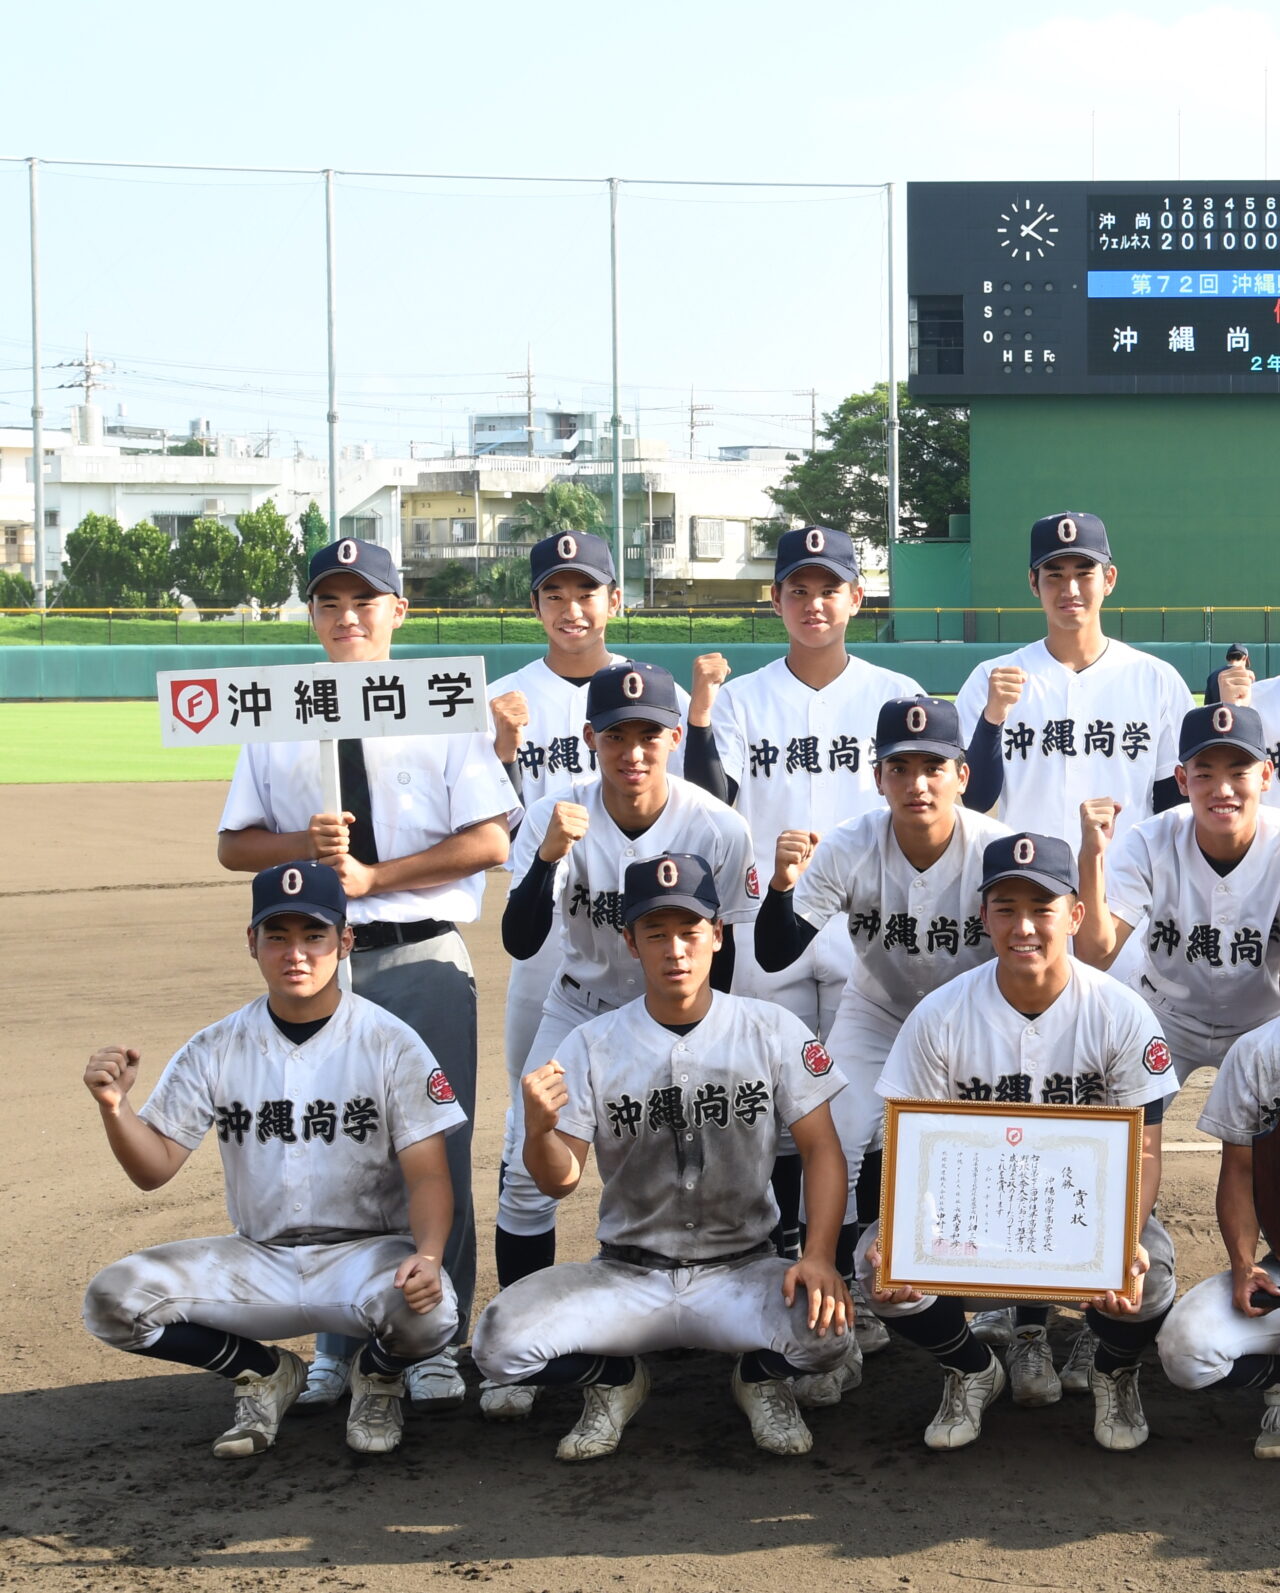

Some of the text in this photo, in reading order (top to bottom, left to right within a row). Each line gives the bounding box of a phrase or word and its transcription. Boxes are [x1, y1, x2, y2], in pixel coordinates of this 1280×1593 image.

[1164, 198, 1169, 209] 1
[1183, 198, 1192, 210] 2
[1204, 198, 1213, 209] 3
[1225, 198, 1234, 209] 4
[1246, 198, 1254, 209] 5
[1267, 198, 1275, 209] 6
[1161, 212, 1172, 228] 0
[1182, 212, 1193, 228] 0
[1203, 212, 1213, 228] 6
[1225, 212, 1231, 228] 1
[1244, 212, 1256, 228] 0
[1265, 212, 1277, 228] 0
[1100, 233, 1150, 250] ウェルネス
[1162, 233, 1172, 249] 2
[1182, 233, 1193, 249] 0
[1205, 233, 1210, 249] 1
[1224, 233, 1235, 249] 0
[1245, 233, 1256, 249] 0
[1265, 233, 1277, 249] 0
[984, 281, 992, 293] B
[984, 306, 992, 318] S
[983, 331, 993, 343] O
[1004, 350, 1012, 362] H
[1025, 350, 1032, 362] E
[227, 672, 476, 727] 沖縄尚学
[1003, 719, 1151, 760] 沖縄尚学
[517, 736, 599, 778] 沖縄
[850, 909, 990, 955] 沖縄尚学
[216, 1098, 379, 1144] 沖縄尚学
[606, 1080, 770, 1138] 沖縄尚学
[1070, 1189, 1088, 1228] 賞状
